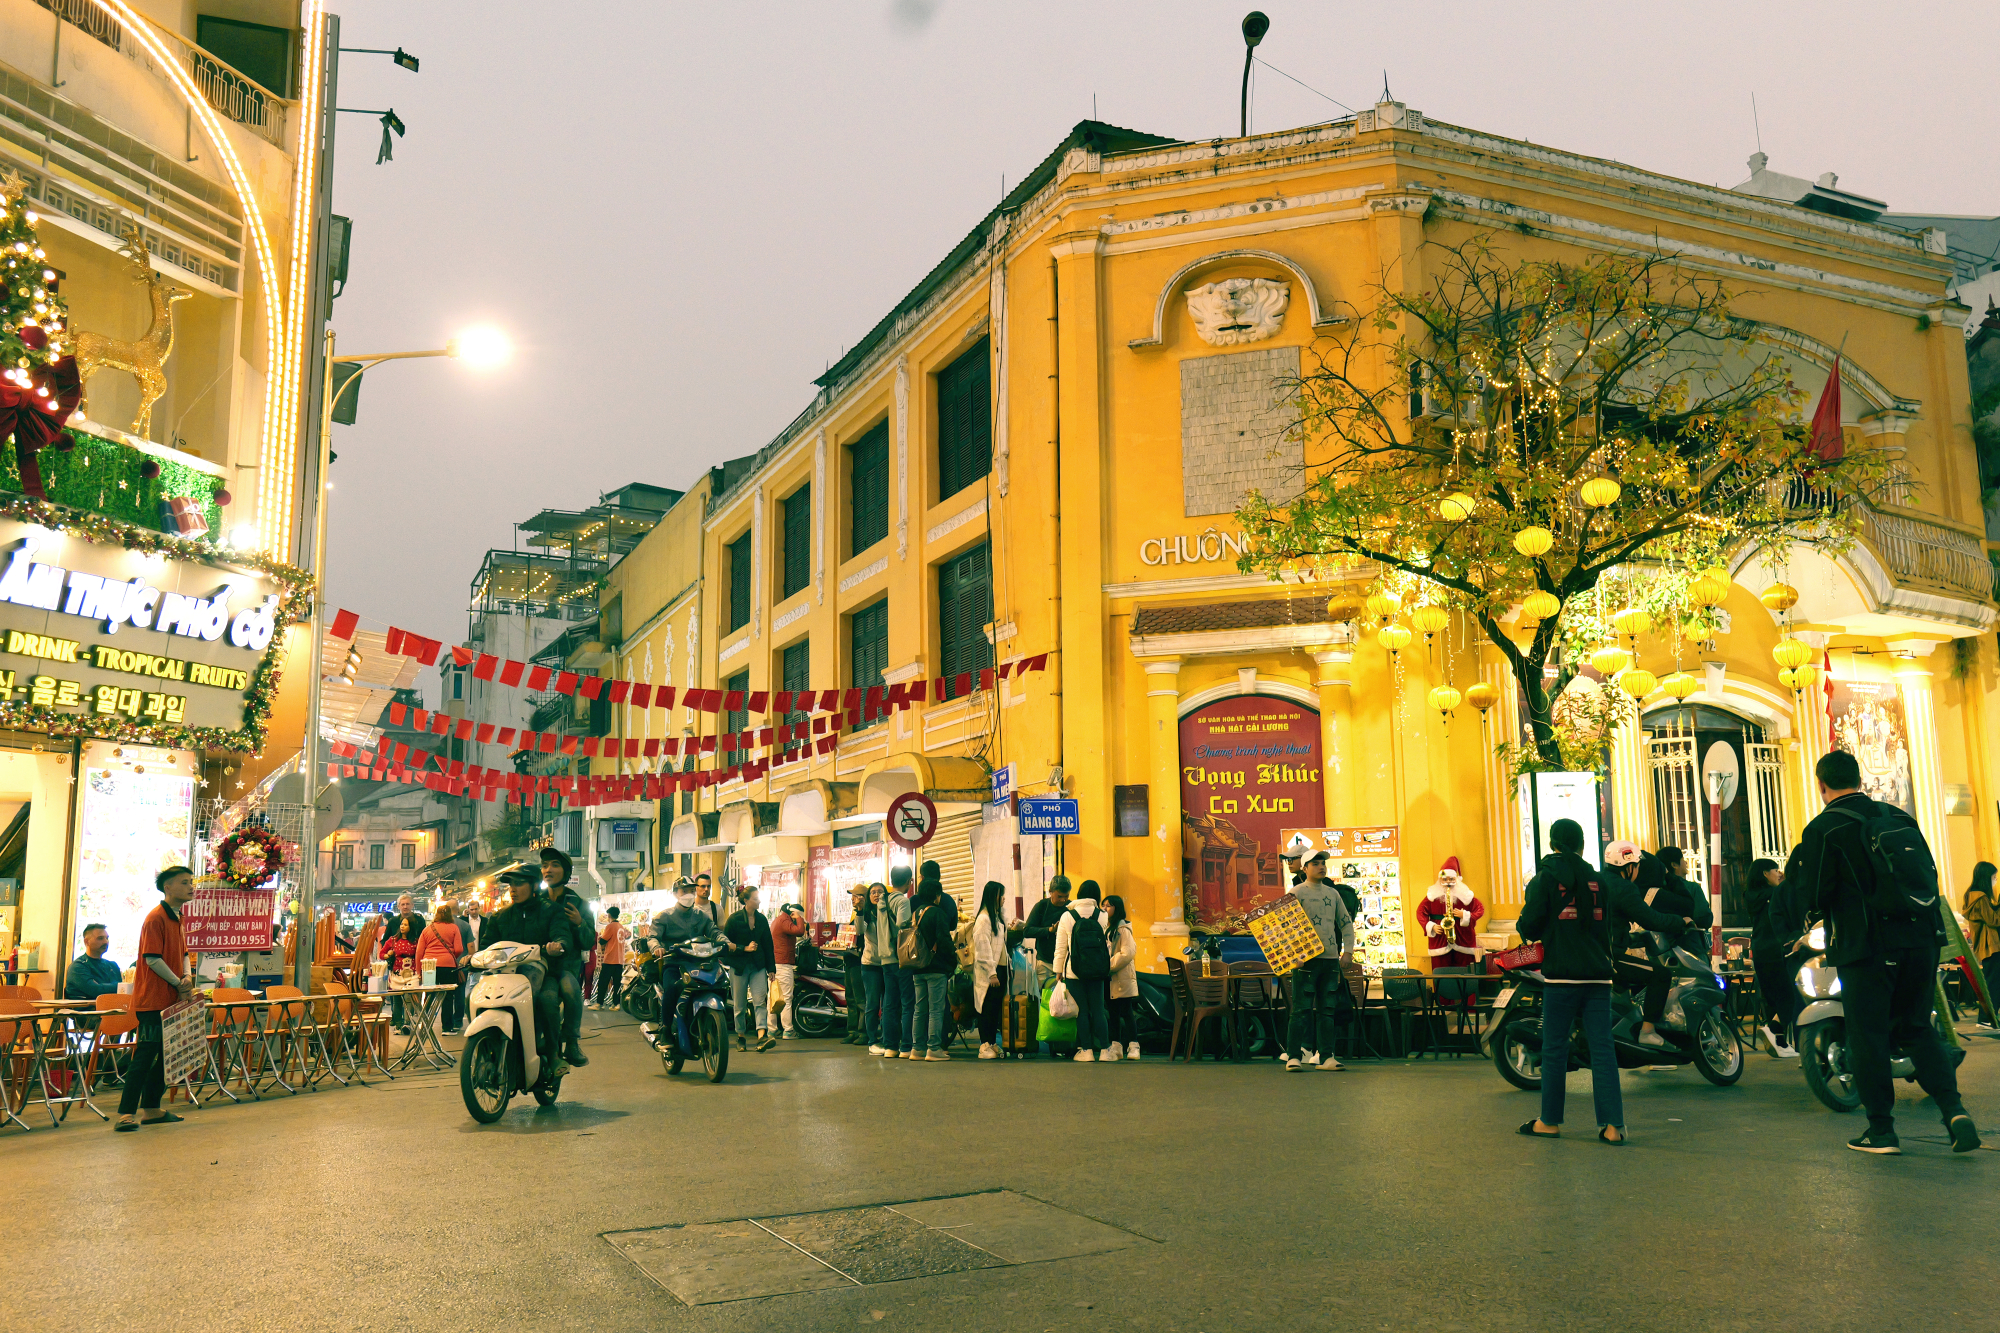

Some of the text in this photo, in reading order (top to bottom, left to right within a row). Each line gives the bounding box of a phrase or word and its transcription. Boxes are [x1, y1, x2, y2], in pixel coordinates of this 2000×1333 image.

[156, 584, 234, 641] PHỐ
[8, 630, 80, 663] DRINK
[96, 646, 185, 681] TROPICAL
[190, 663, 248, 690] FRUITS
[32, 676, 80, 706] 음료
[97, 685, 142, 718] 열대
[144, 693, 186, 723] 과일
[1209, 722, 1289, 733] NHÀ HÁT CẢI LƯƠNG
[1183, 763, 1320, 790] Vọng Khúc
[1042, 802, 1061, 812] PHỐ
[1210, 794, 1295, 814] Ca Xưa
[1024, 813, 1075, 831] HÀNG BẠC
[219, 919, 231, 931] BẾP
[234, 921, 250, 933] CHẠY
[186, 935, 199, 946] LH
[206, 934, 266, 946] 0913.019.955
